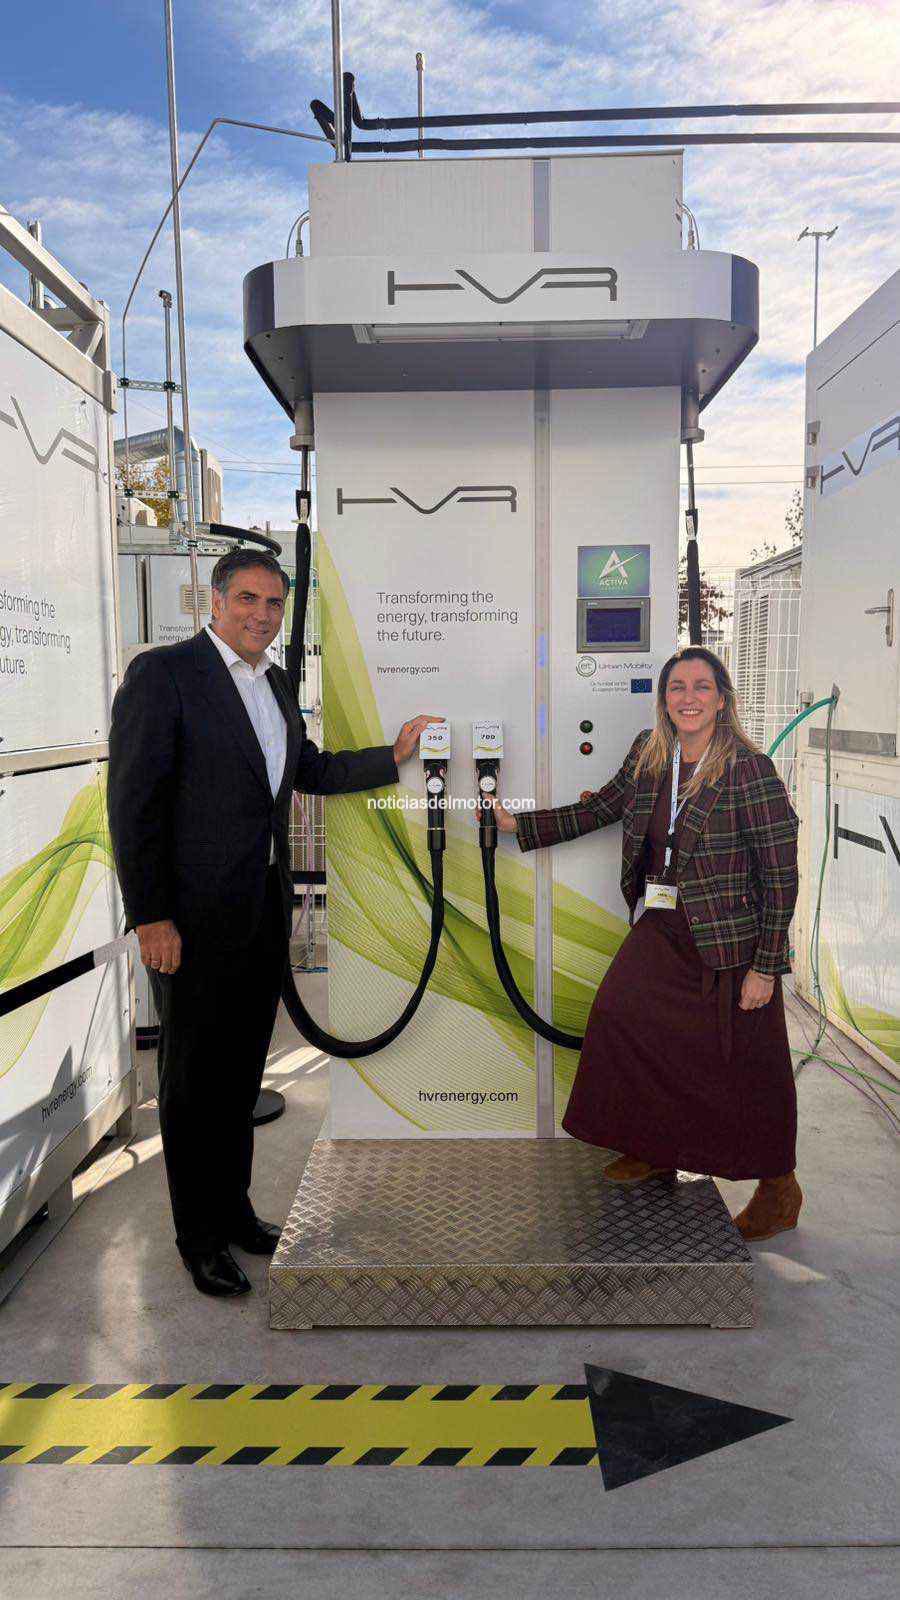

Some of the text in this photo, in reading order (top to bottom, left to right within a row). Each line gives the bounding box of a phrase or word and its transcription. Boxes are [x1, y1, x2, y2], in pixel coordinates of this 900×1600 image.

[387, 267, 617, 305] HVR
[337, 485, 518, 515] HVR
[376, 590, 494, 606] Transforming the
[41, 598, 56, 618] the
[376, 609, 518, 625] energy, transforming
[15, 625, 71, 655] transforming
[376, 629, 445, 641] the future.
[377, 665, 440, 675] hvrenergy.com
[418, 1090, 519, 1105] hvrenergy.com
